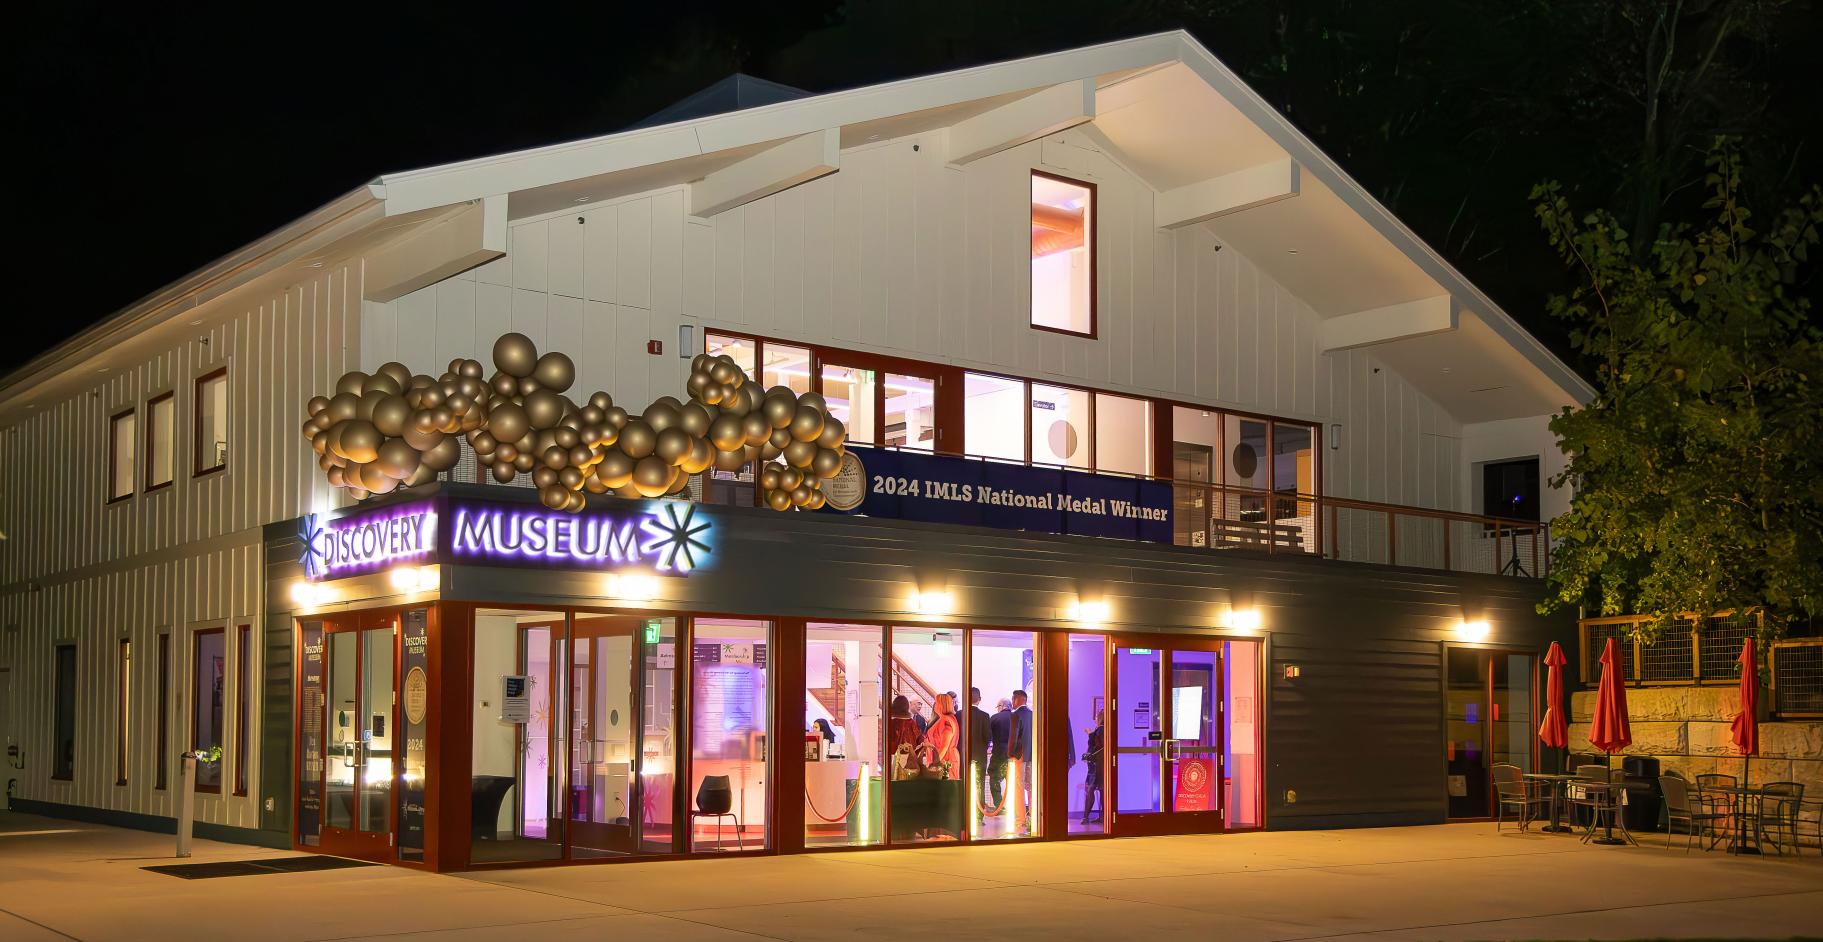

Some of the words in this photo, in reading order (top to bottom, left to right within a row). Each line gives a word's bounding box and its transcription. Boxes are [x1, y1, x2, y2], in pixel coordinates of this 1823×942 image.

[873, 475, 920, 496] 2024
[924, 480, 973, 502] IMLS
[977, 485, 1053, 510] National
[1057, 493, 1107, 516] Medal
[1110, 499, 1168, 522] Winner
[324, 513, 427, 567] DISCOVERY
[457, 510, 642, 560] MUSEUM
[405, 636, 427, 647] DISCOVER
[408, 738, 424, 751] 2024
